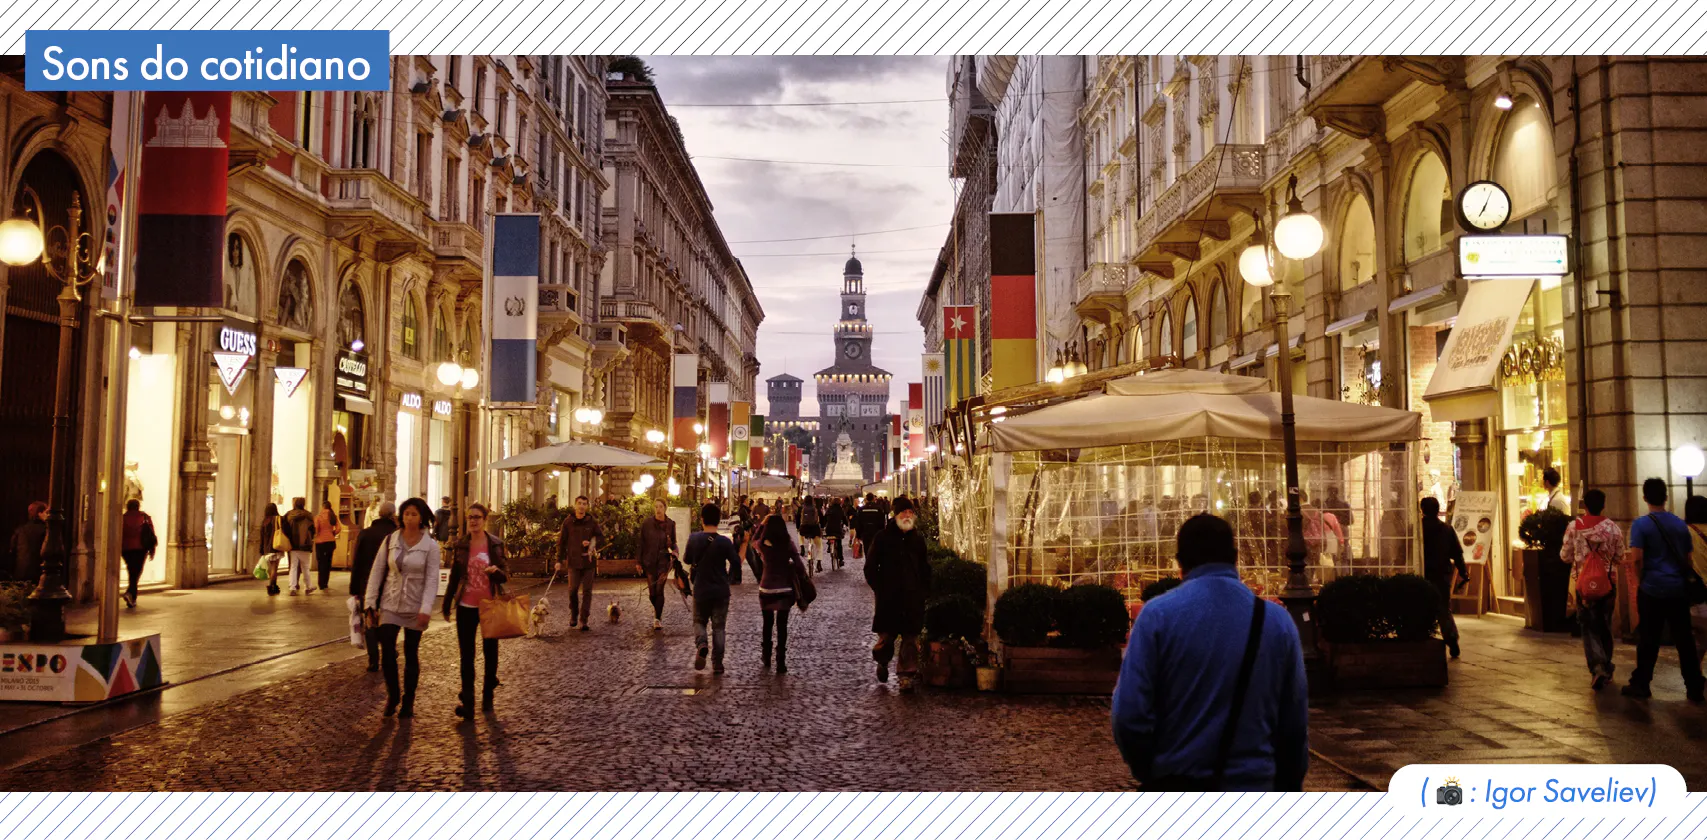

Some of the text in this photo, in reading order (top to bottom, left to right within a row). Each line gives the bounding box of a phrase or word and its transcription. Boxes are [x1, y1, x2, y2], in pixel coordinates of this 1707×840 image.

[220, 328, 256, 356] GUESS
[402, 393, 421, 410] ALDO
[434, 400, 452, 416] ALDO
[3, 653, 67, 673] EXPO
